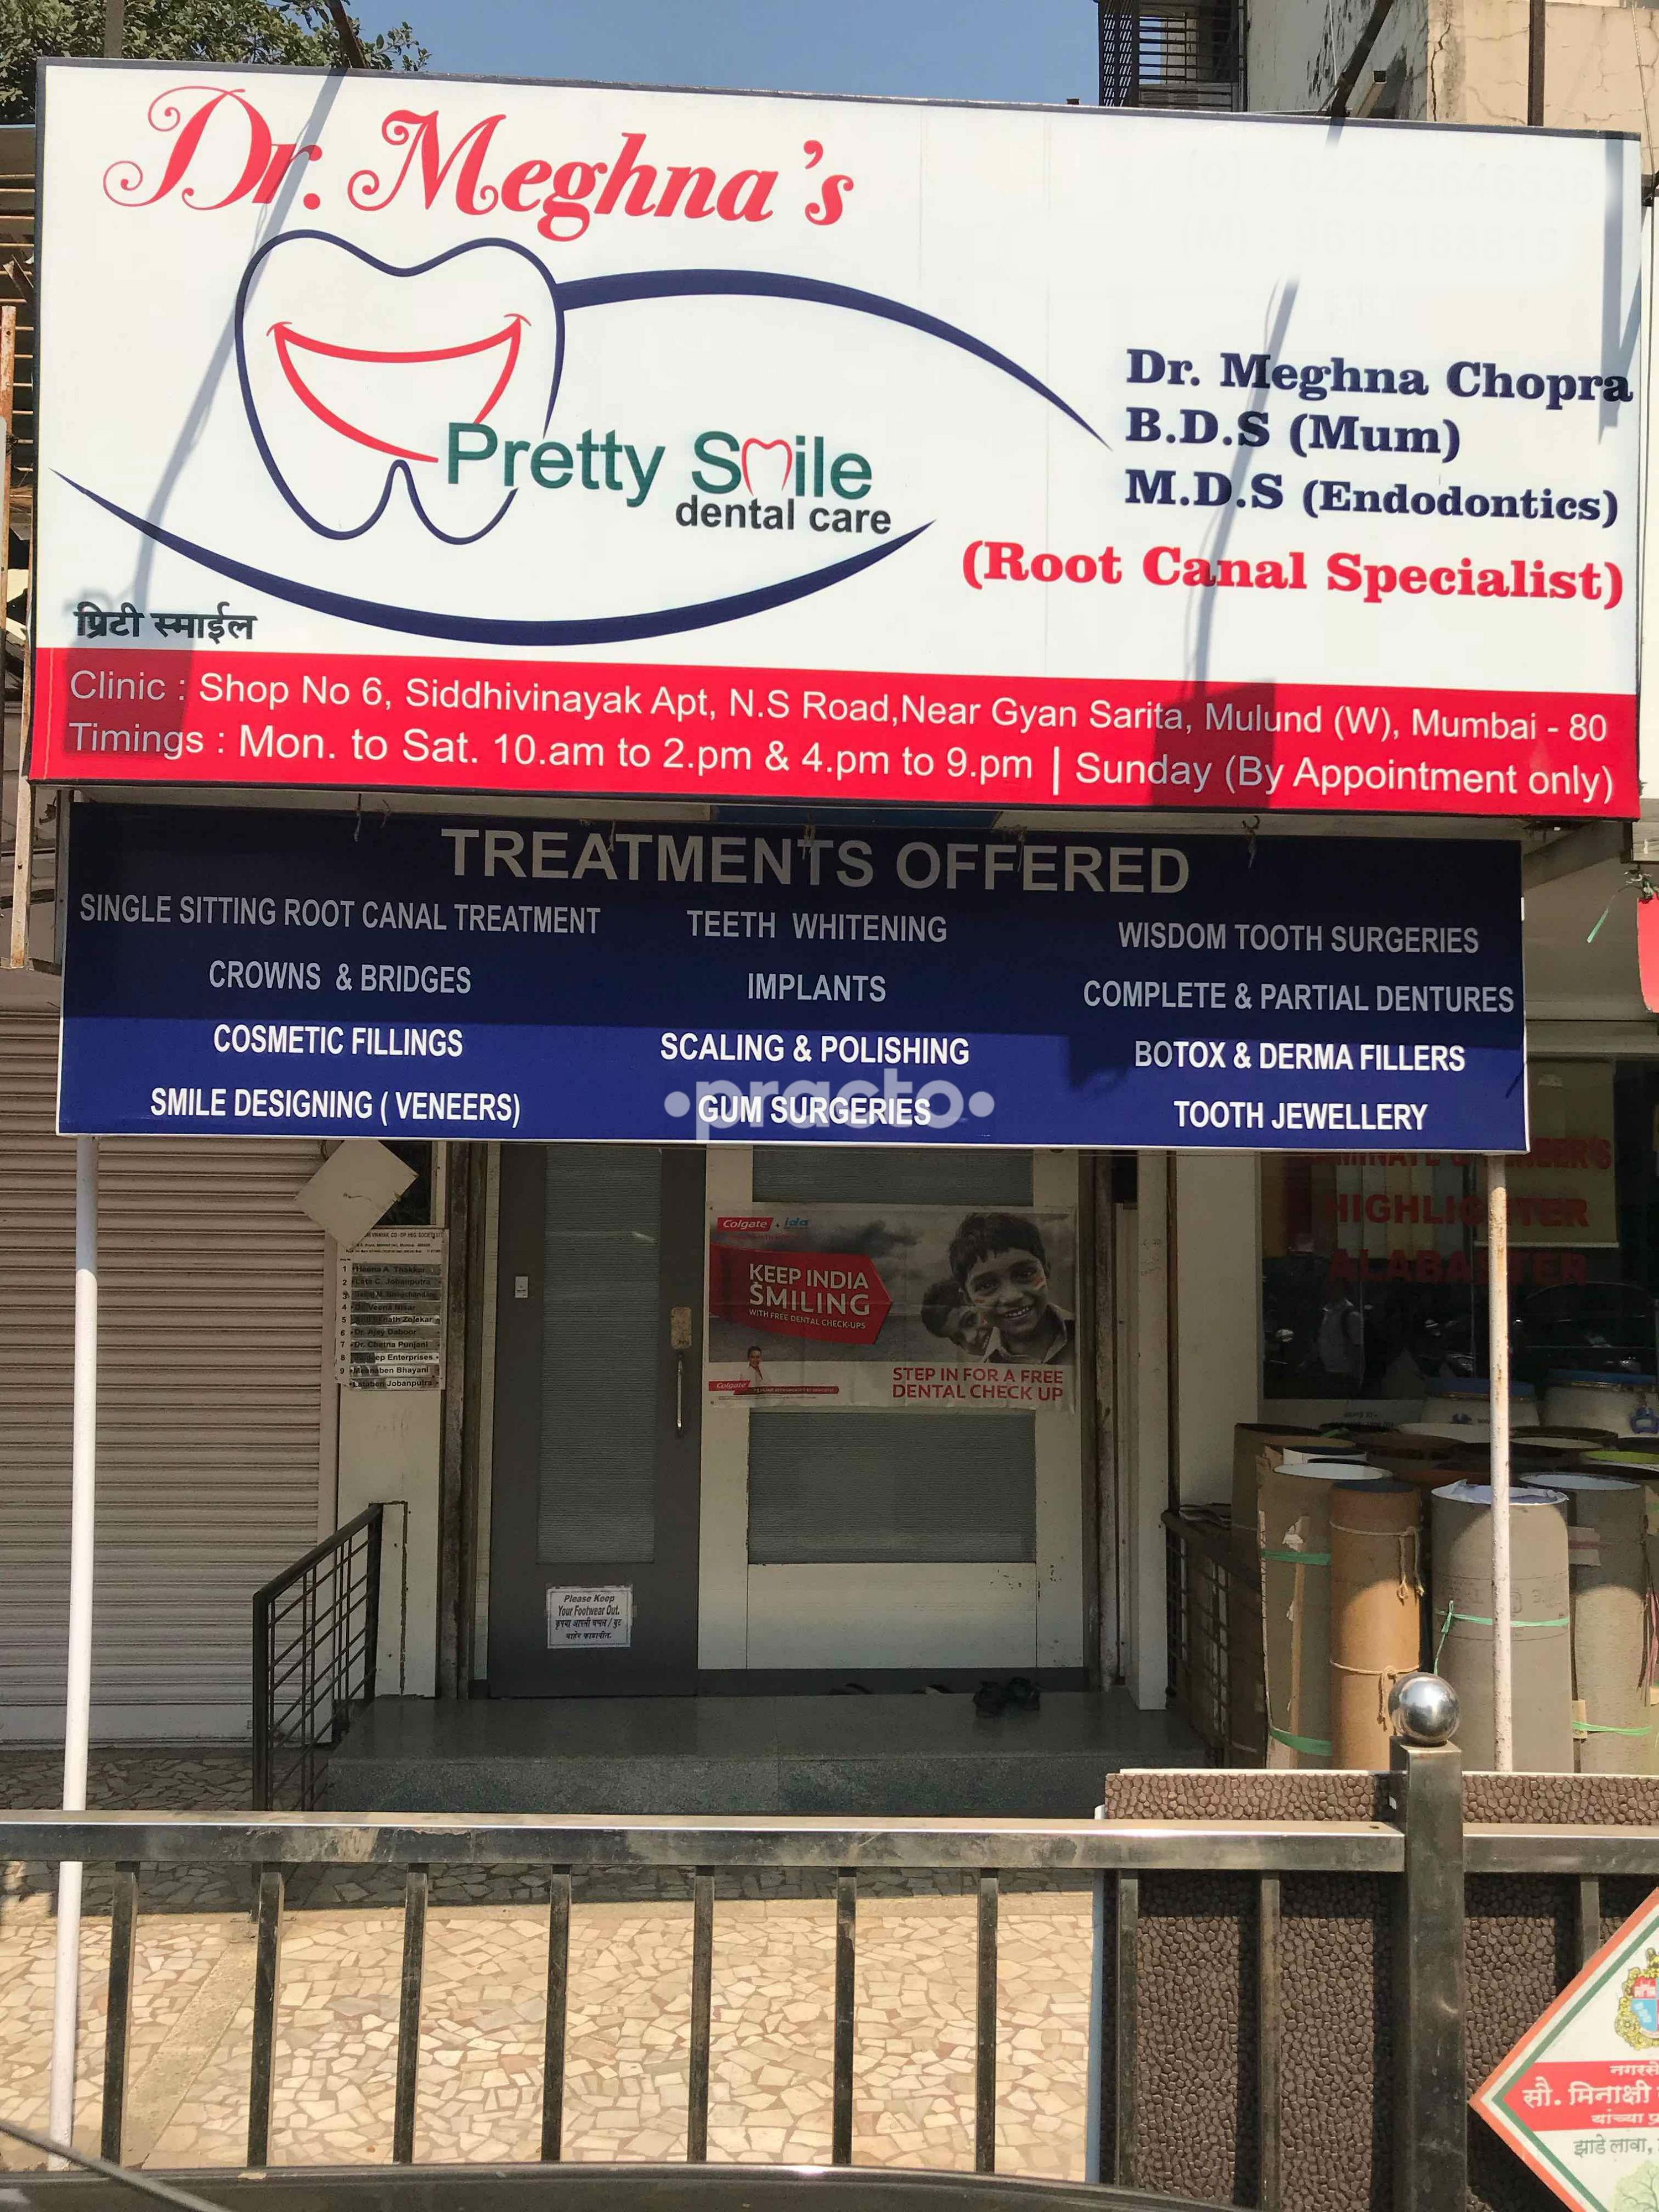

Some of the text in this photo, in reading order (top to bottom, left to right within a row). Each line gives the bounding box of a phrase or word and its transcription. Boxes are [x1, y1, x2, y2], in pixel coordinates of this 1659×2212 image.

[103, 85, 854, 242] Dr. Meghna's
[1126, 348, 1634, 411] Dr. Meghna Chopra
[1125, 406, 1461, 463] B.D.S (Mum)
[446, 421, 666, 506] Pretty
[675, 493, 892, 535] dental care
[1124, 468, 1620, 528] M.D.S (Endodontics)
[962, 539, 1624, 611] (Root Canal Specialist)
[72, 601, 258, 644] प्रिटी स्माईल
[70, 669, 165, 702] Clinic
[199, 671, 289, 710] Shop
[302, 675, 349, 706] No
[362, 677, 392, 711] 6,
[405, 677, 641, 721] Siddhivinayak
[650, 686, 716, 722] Apt,
[730, 688, 790, 719] N.S
[992, 697, 1077, 734] Gyan
[1089, 700, 1193, 735] Sarita,
[1205, 702, 1322, 734] Mulund
[1334, 705, 1399, 741] (W),
[1412, 709, 1537, 741] Mumbai
[1569, 713, 1607, 743] 80
[69, 722, 1614, 804] Timings Mon. to Sat. 10.am to 2.pm & 4.pm to 9.pm Sunday (By Appointment only)
[441, 828, 1189, 894] TREATMENTS OFFERED
[80, 893, 601, 935] SINGLE SITTING ROOT CANAL TREATMENT
[687, 910, 947, 943] TEETH WHITENING
[1118, 921, 1479, 954] WISDOM TOOTH SURGERIES
[209, 959, 472, 995] CROWNS & BRIDGES
[748, 973, 886, 1002] IMPLANTS
[1083, 980, 1514, 1013] COMPLETE & PARTIAL DENTURES
[213, 1024, 463, 1057] COSMETIC FILLINGS
[660, 1032, 970, 1066] SCALING & POLISHING
[1135, 1040, 1465, 1072] BOTOX & DERMA FILLERS
[150, 1086, 227, 1117] SMILE
[234, 1088, 373, 1119] DESIGNING
[697, 1094, 931, 1126] GUM SURGERIES
[1174, 1101, 1428, 1131] TOOTH JEWELLERY
[722, 1219, 768, 1230] Colgate
[750, 1264, 869, 1289] KEEP INDIA
[750, 1284, 870, 1316] SMILING
[749, 1308, 866, 1329] WITH FREE DENTAL CHECK-UPS
[397, 1366, 429, 1375] Bhayani
[893, 1367, 1063, 1384] STEP IN FOR A FREE
[893, 1384, 1063, 1401] DENTAL CHECK UP
[558, 1605, 620, 1616] Your Footwear Out.
[593, 1594, 615, 1604] Keep
[1522, 2076, 1561, 2109] सौ.
[1568, 2079, 1652, 2105] मिनाक्षी
[1573, 2133, 1606, 2158] झाडे
